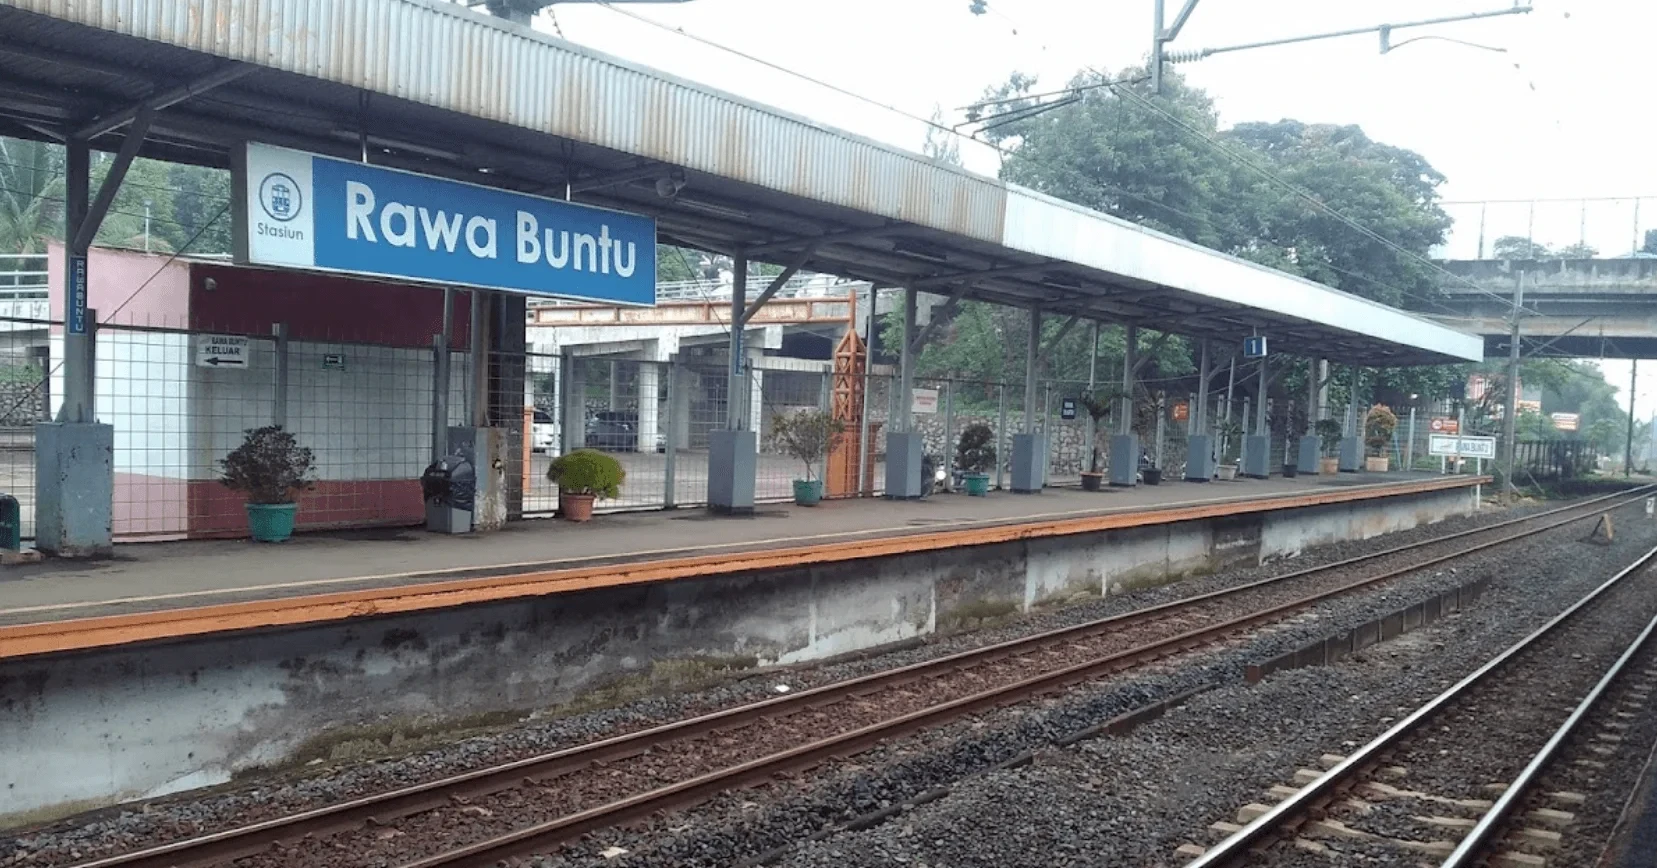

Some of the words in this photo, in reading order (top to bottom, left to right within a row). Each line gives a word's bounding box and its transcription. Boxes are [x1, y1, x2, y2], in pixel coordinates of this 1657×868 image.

[257, 222, 304, 240] Stasiun
[346, 180, 497, 259] Rawa
[516, 210, 636, 278] Buntu
[204, 346, 241, 355] KELUAR
[1251, 339, 1257, 354] 1
